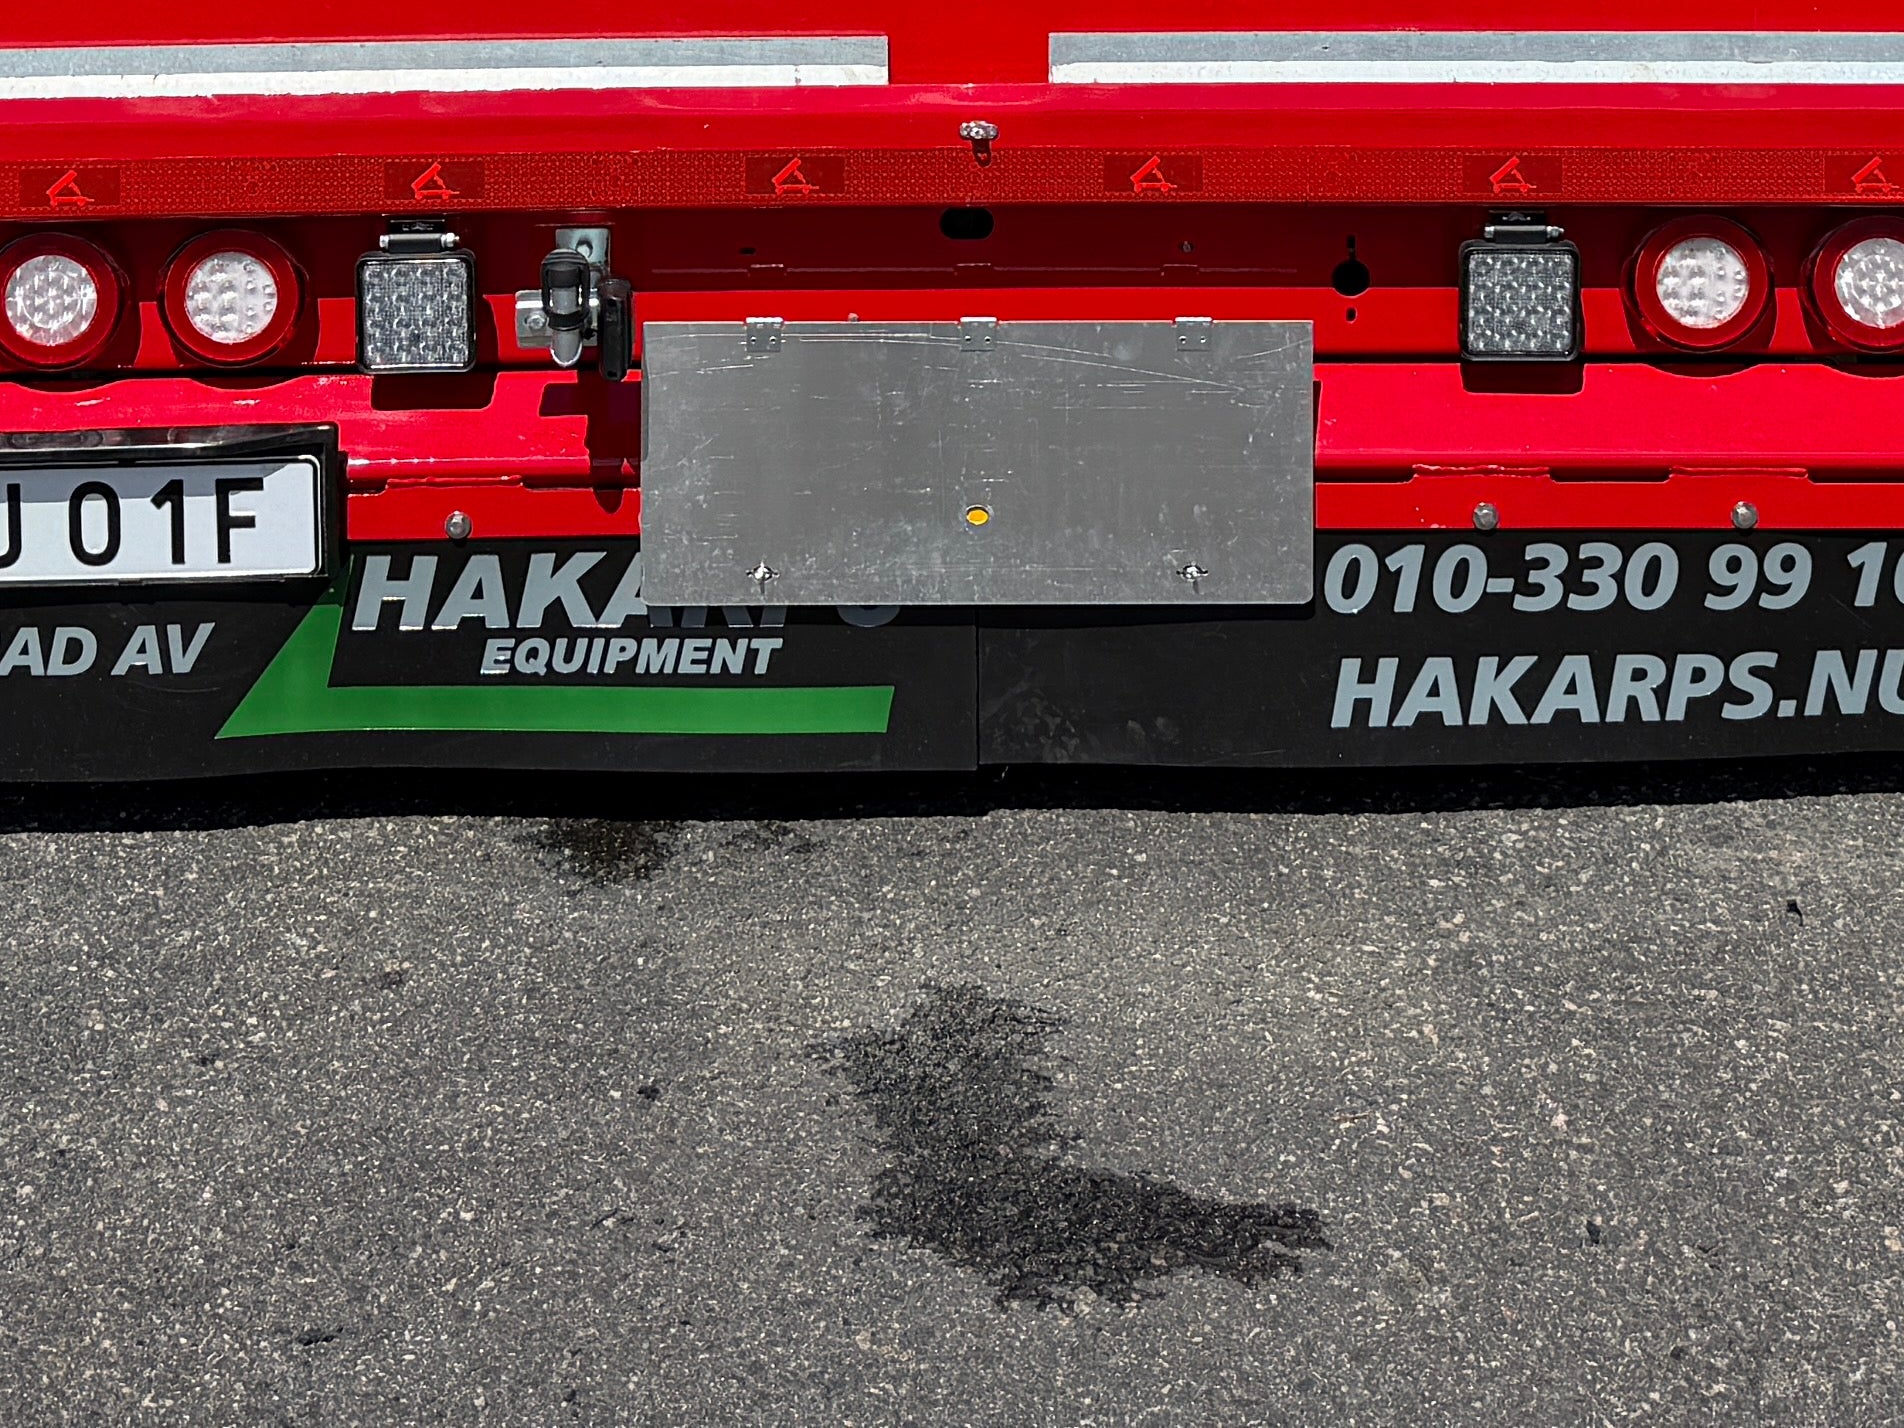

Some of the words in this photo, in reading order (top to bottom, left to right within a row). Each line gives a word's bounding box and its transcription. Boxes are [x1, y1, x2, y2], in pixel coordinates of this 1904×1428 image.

[67, 477, 265, 566] 01F
[352, 552, 901, 630] HAKA
[1322, 542, 1680, 614] 010-330
[1703, 540, 1814, 610] 99
[110, 621, 216, 676] AV
[480, 637, 784, 677] EQUIPMENT
